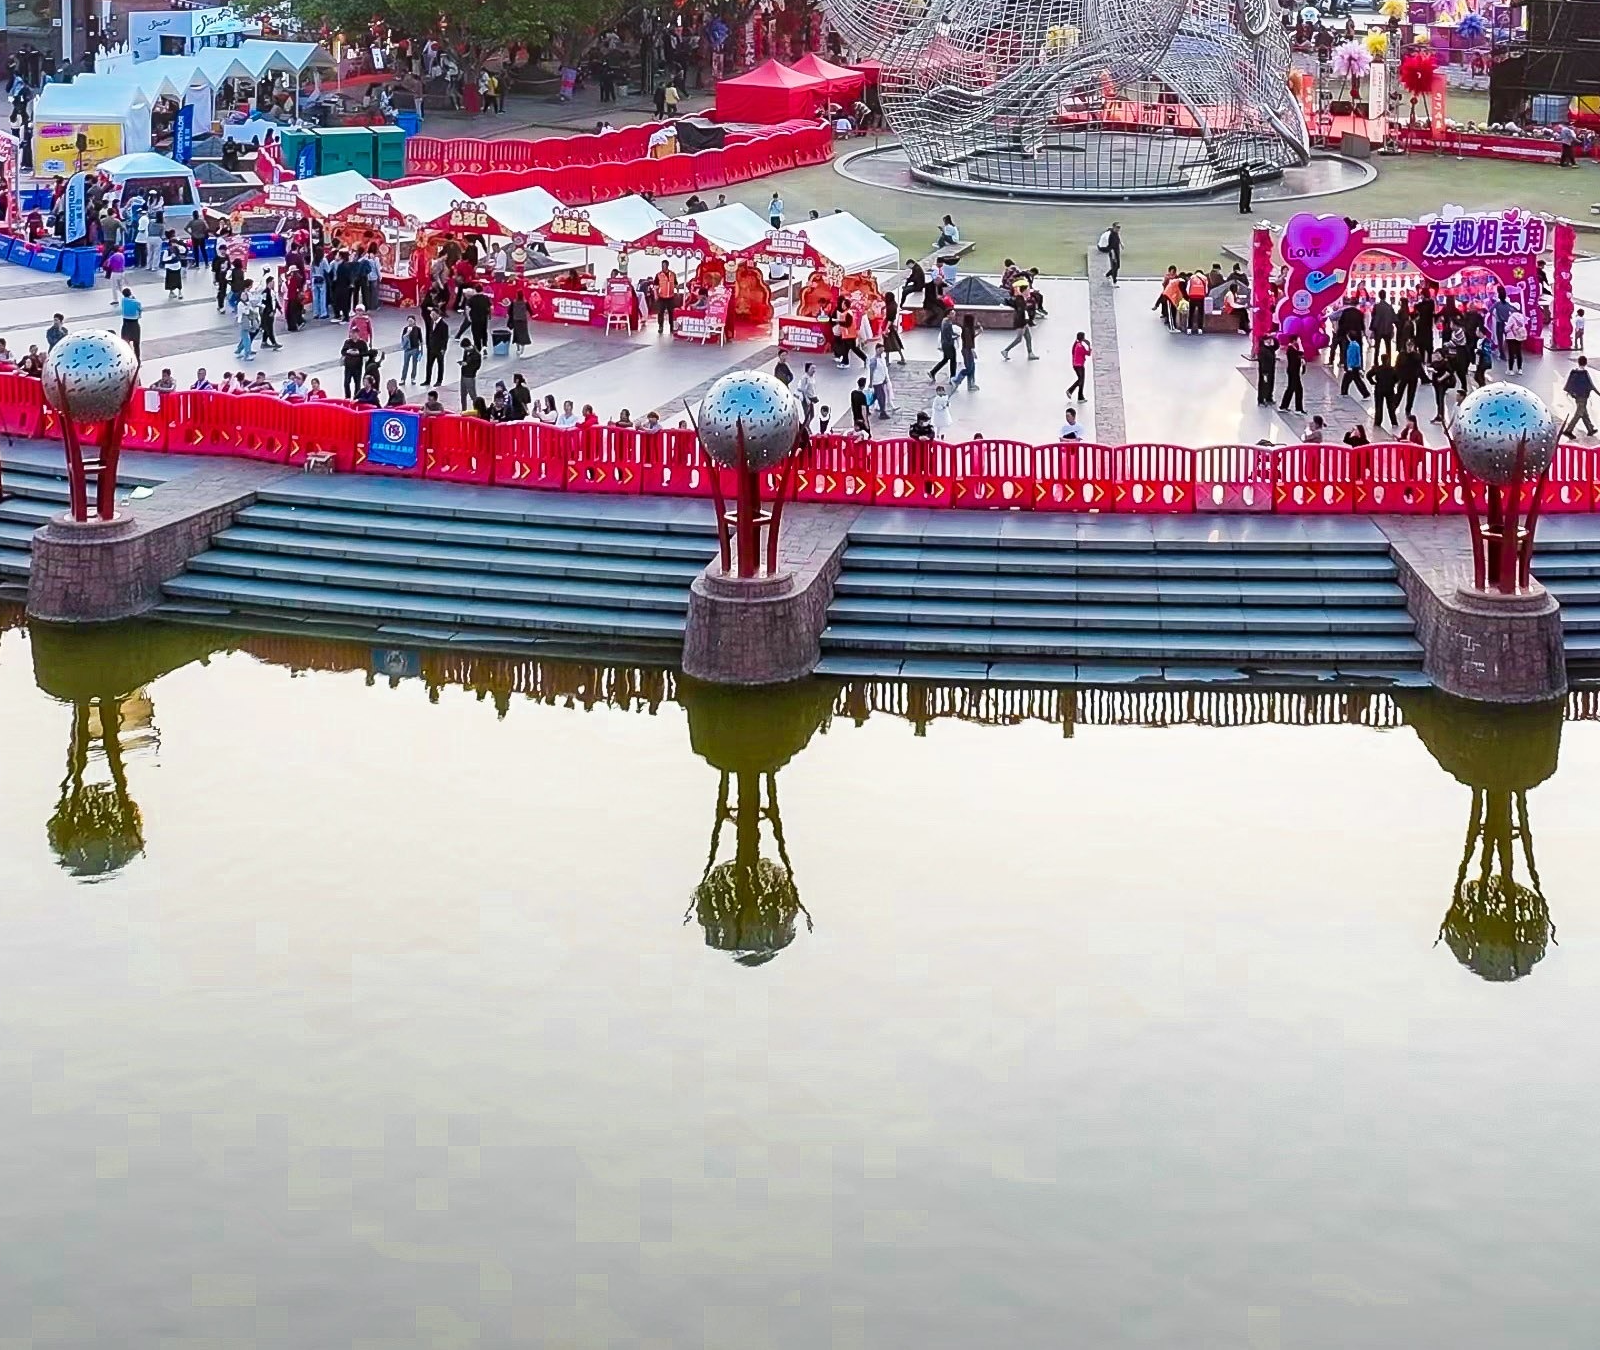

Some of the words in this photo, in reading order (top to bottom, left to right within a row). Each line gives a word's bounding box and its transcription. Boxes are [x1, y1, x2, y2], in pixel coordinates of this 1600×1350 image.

[1426, 219, 1546, 256] 友趣相亲角
[1289, 248, 1321, 259] LOVE
